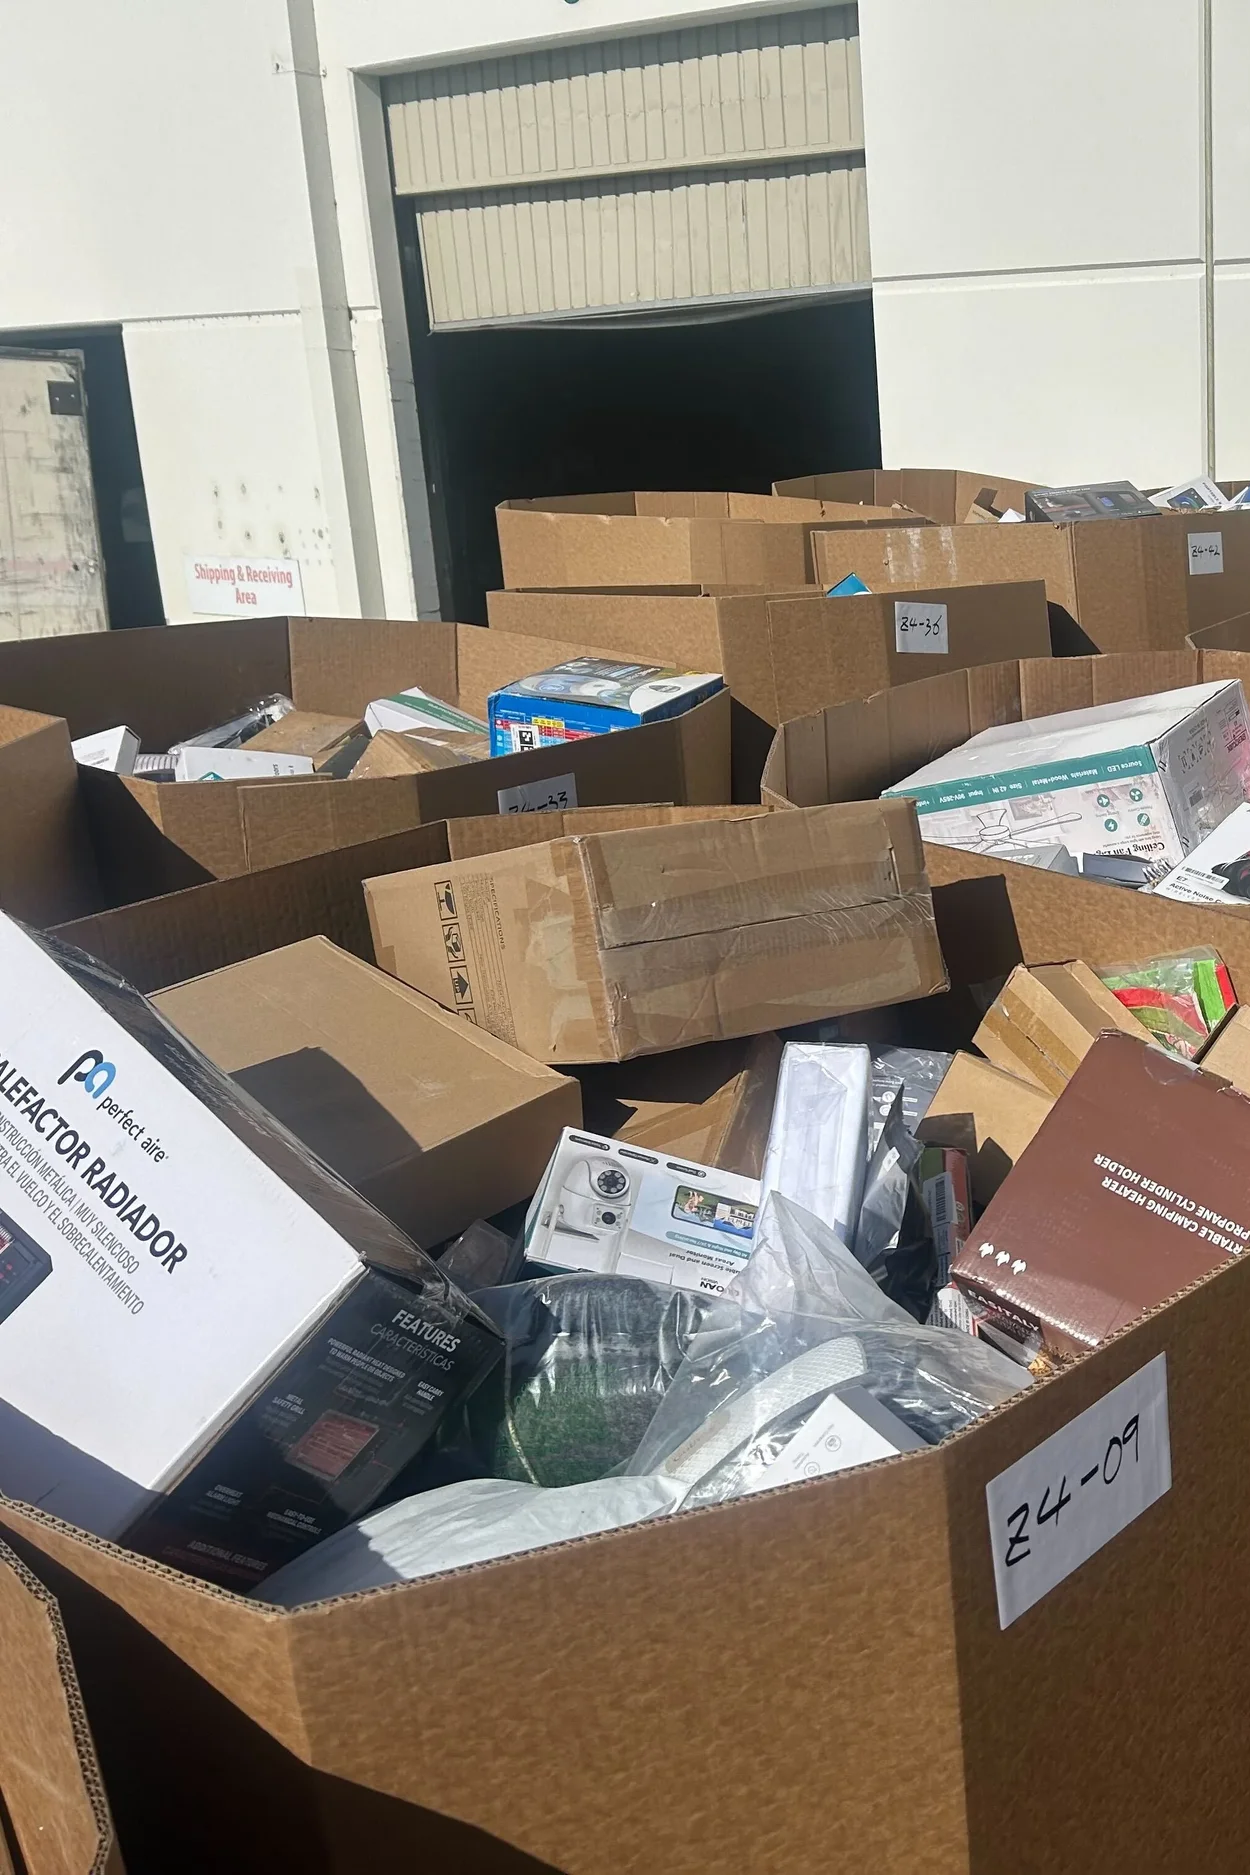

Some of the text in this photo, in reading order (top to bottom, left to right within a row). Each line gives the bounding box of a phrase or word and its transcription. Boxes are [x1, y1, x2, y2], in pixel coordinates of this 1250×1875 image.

[194, 563, 293, 589] Shipping & Receiving
[235, 588, 257, 606] Area
[1070, 768, 1099, 781] Materials
[1106, 760, 1143, 773] Source LED
[967, 790, 984, 799] Input
[999, 785, 1008, 793] 42
[1009, 782, 1023, 791] Size
[1132, 841, 1165, 855] Ceiling
[1176, 875, 1188, 883] E7
[1169, 883, 1192, 895] Active
[1194, 891, 1217, 902] Noise
[490, 877, 506, 950] SPECIFICATIONS
[96, 1095, 167, 1164] perfect aire
[0, 1054, 187, 1274] ALEFACTOR RADIADOR
[1094, 1153, 1250, 1241] PROPANE CYLINDER HOLDER
[37, 1162, 77, 1209] METÁLICA
[74, 1201, 98, 1228] MUY
[94, 1221, 140, 1274] SILENCIOSO
[1101, 1176, 1244, 1255] RTABLE CAMPING HEATER
[6, 1160, 19, 1179] EL
[16, 1170, 49, 1208] VUELCO
[57, 1217, 145, 1316] SOBRECALENTAMIENTO
[669, 1252, 686, 1261] Dual
[685, 1250, 735, 1266] Areas Monitor
[686, 1257, 701, 1265] and
[701, 1260, 724, 1271] Screen
[391, 1309, 462, 1353] FEATURES
[370, 1323, 455, 1372] CARACTERÍSTICAS
[327, 1337, 353, 1354] POWERFUL
[352, 1349, 373, 1365] RADIANT
[382, 1363, 406, 1379] DESIGNED
[336, 1349, 353, 1365] WARM
[350, 1357, 368, 1373] PEOPLE
[373, 1369, 396, 1383] OBJECTS
[416, 1389, 436, 1402] HANDLE
[417, 1381, 445, 1397] EASY CARRY
[272, 1396, 293, 1411] SAFETY
[290, 1403, 306, 1416] GRILL
